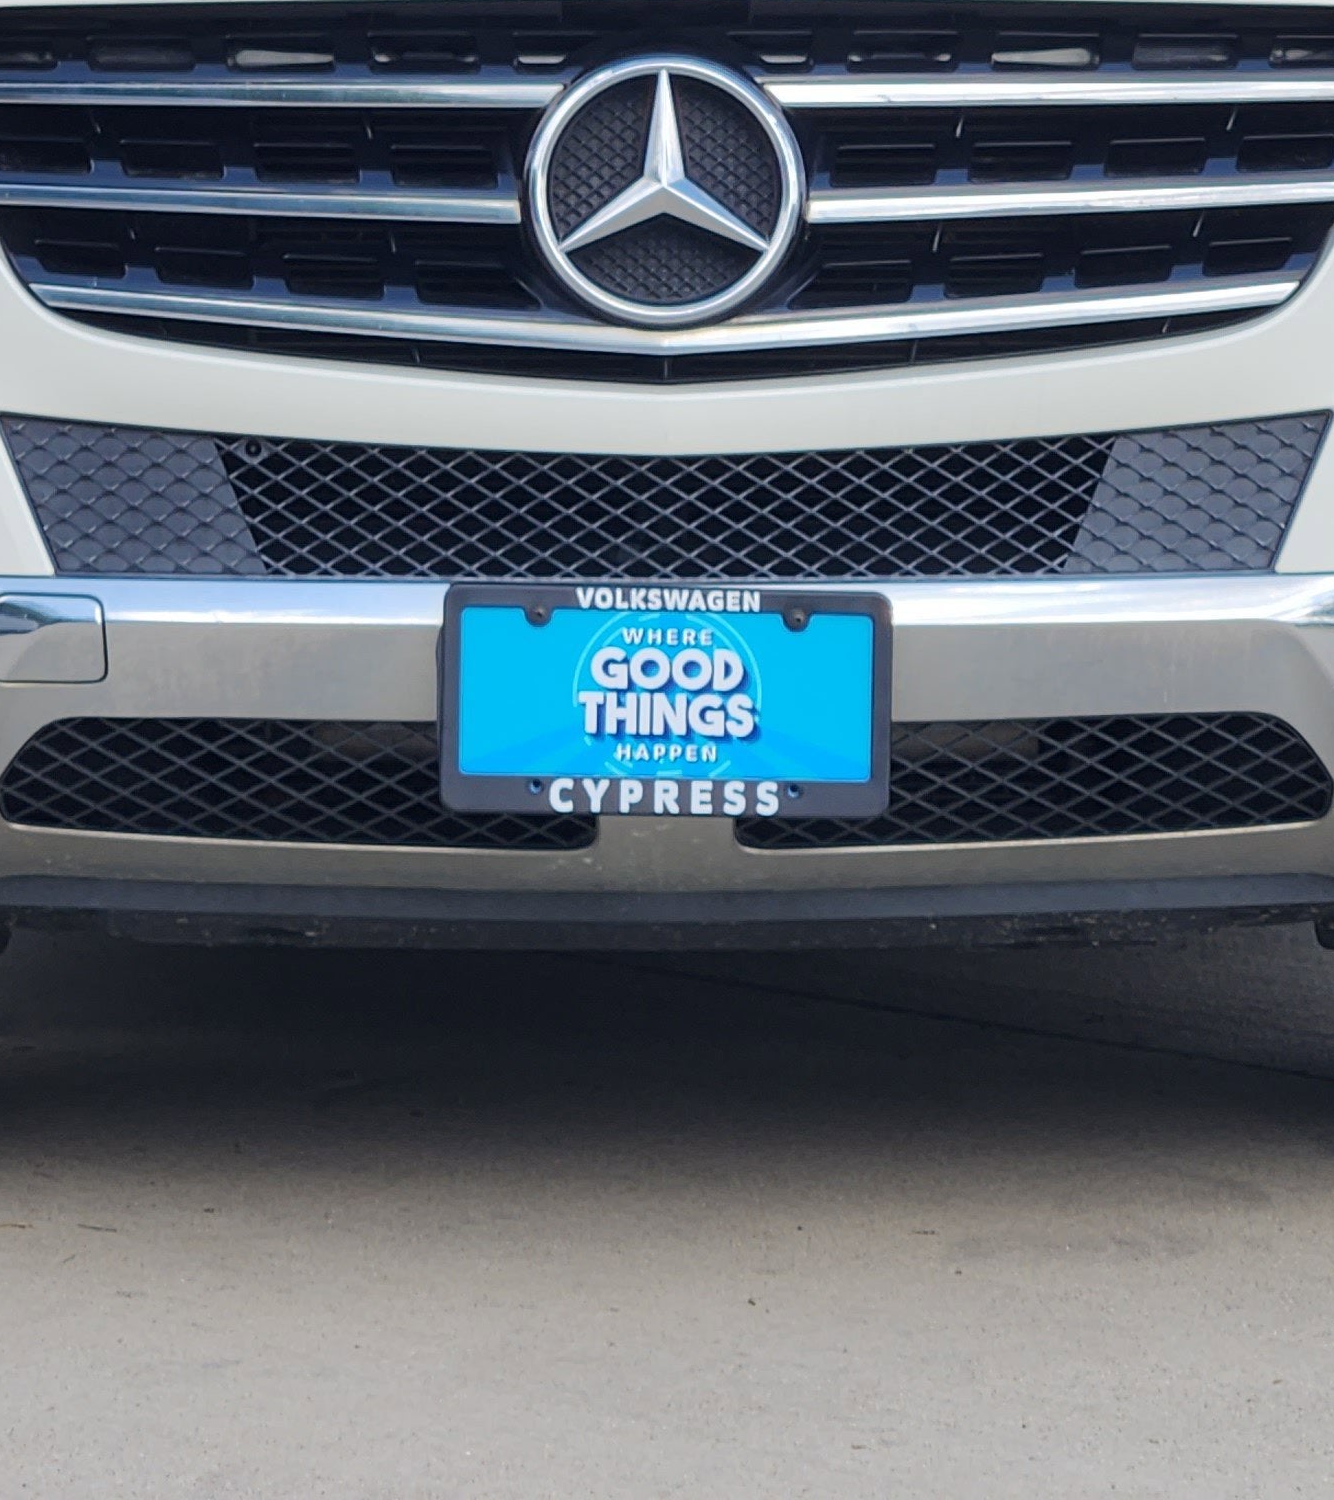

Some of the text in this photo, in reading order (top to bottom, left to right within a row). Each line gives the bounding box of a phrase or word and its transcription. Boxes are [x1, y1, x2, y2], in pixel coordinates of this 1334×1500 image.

[576, 586, 761, 613] VOLKSWAGEN
[621, 627, 715, 647] WHERE
[590, 645, 745, 692] GOOD
[578, 691, 756, 738] THINGS
[615, 743, 719, 764] HAPPEN
[548, 777, 780, 818] CYPRESS
